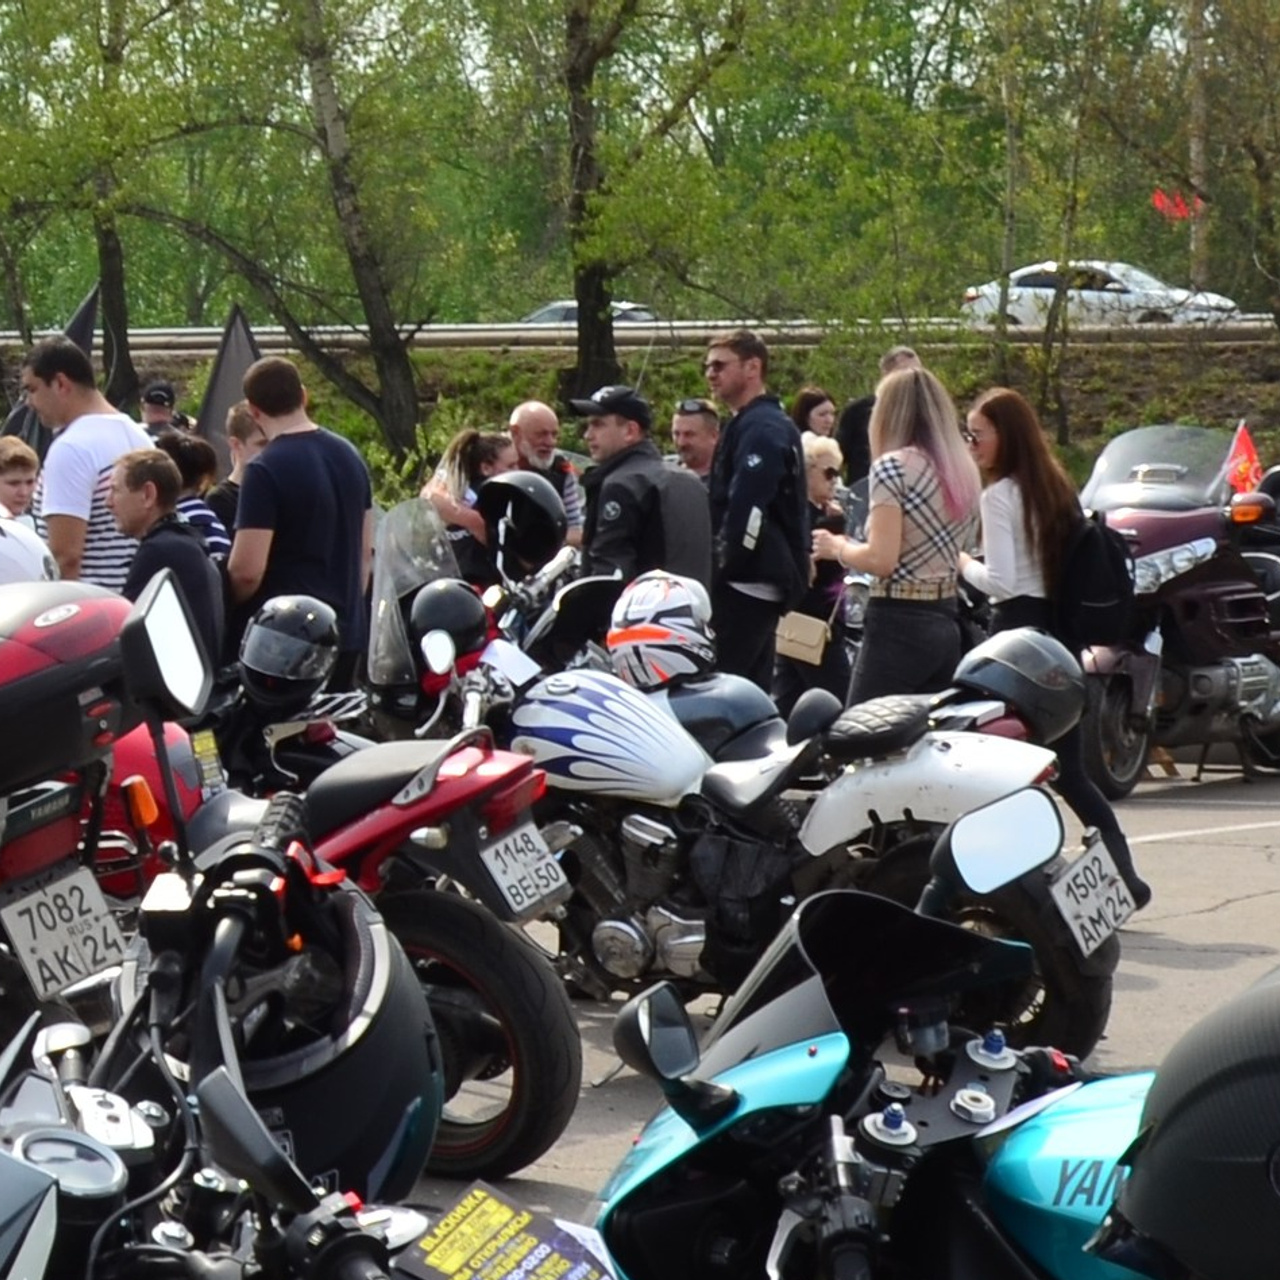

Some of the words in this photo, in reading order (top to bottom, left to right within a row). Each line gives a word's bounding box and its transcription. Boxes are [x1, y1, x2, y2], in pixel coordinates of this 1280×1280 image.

[1066, 856, 1108, 904] 1502
[18, 885, 92, 940] 7082
[1105, 885, 1131, 921] 24
[83, 925, 122, 968] 24
